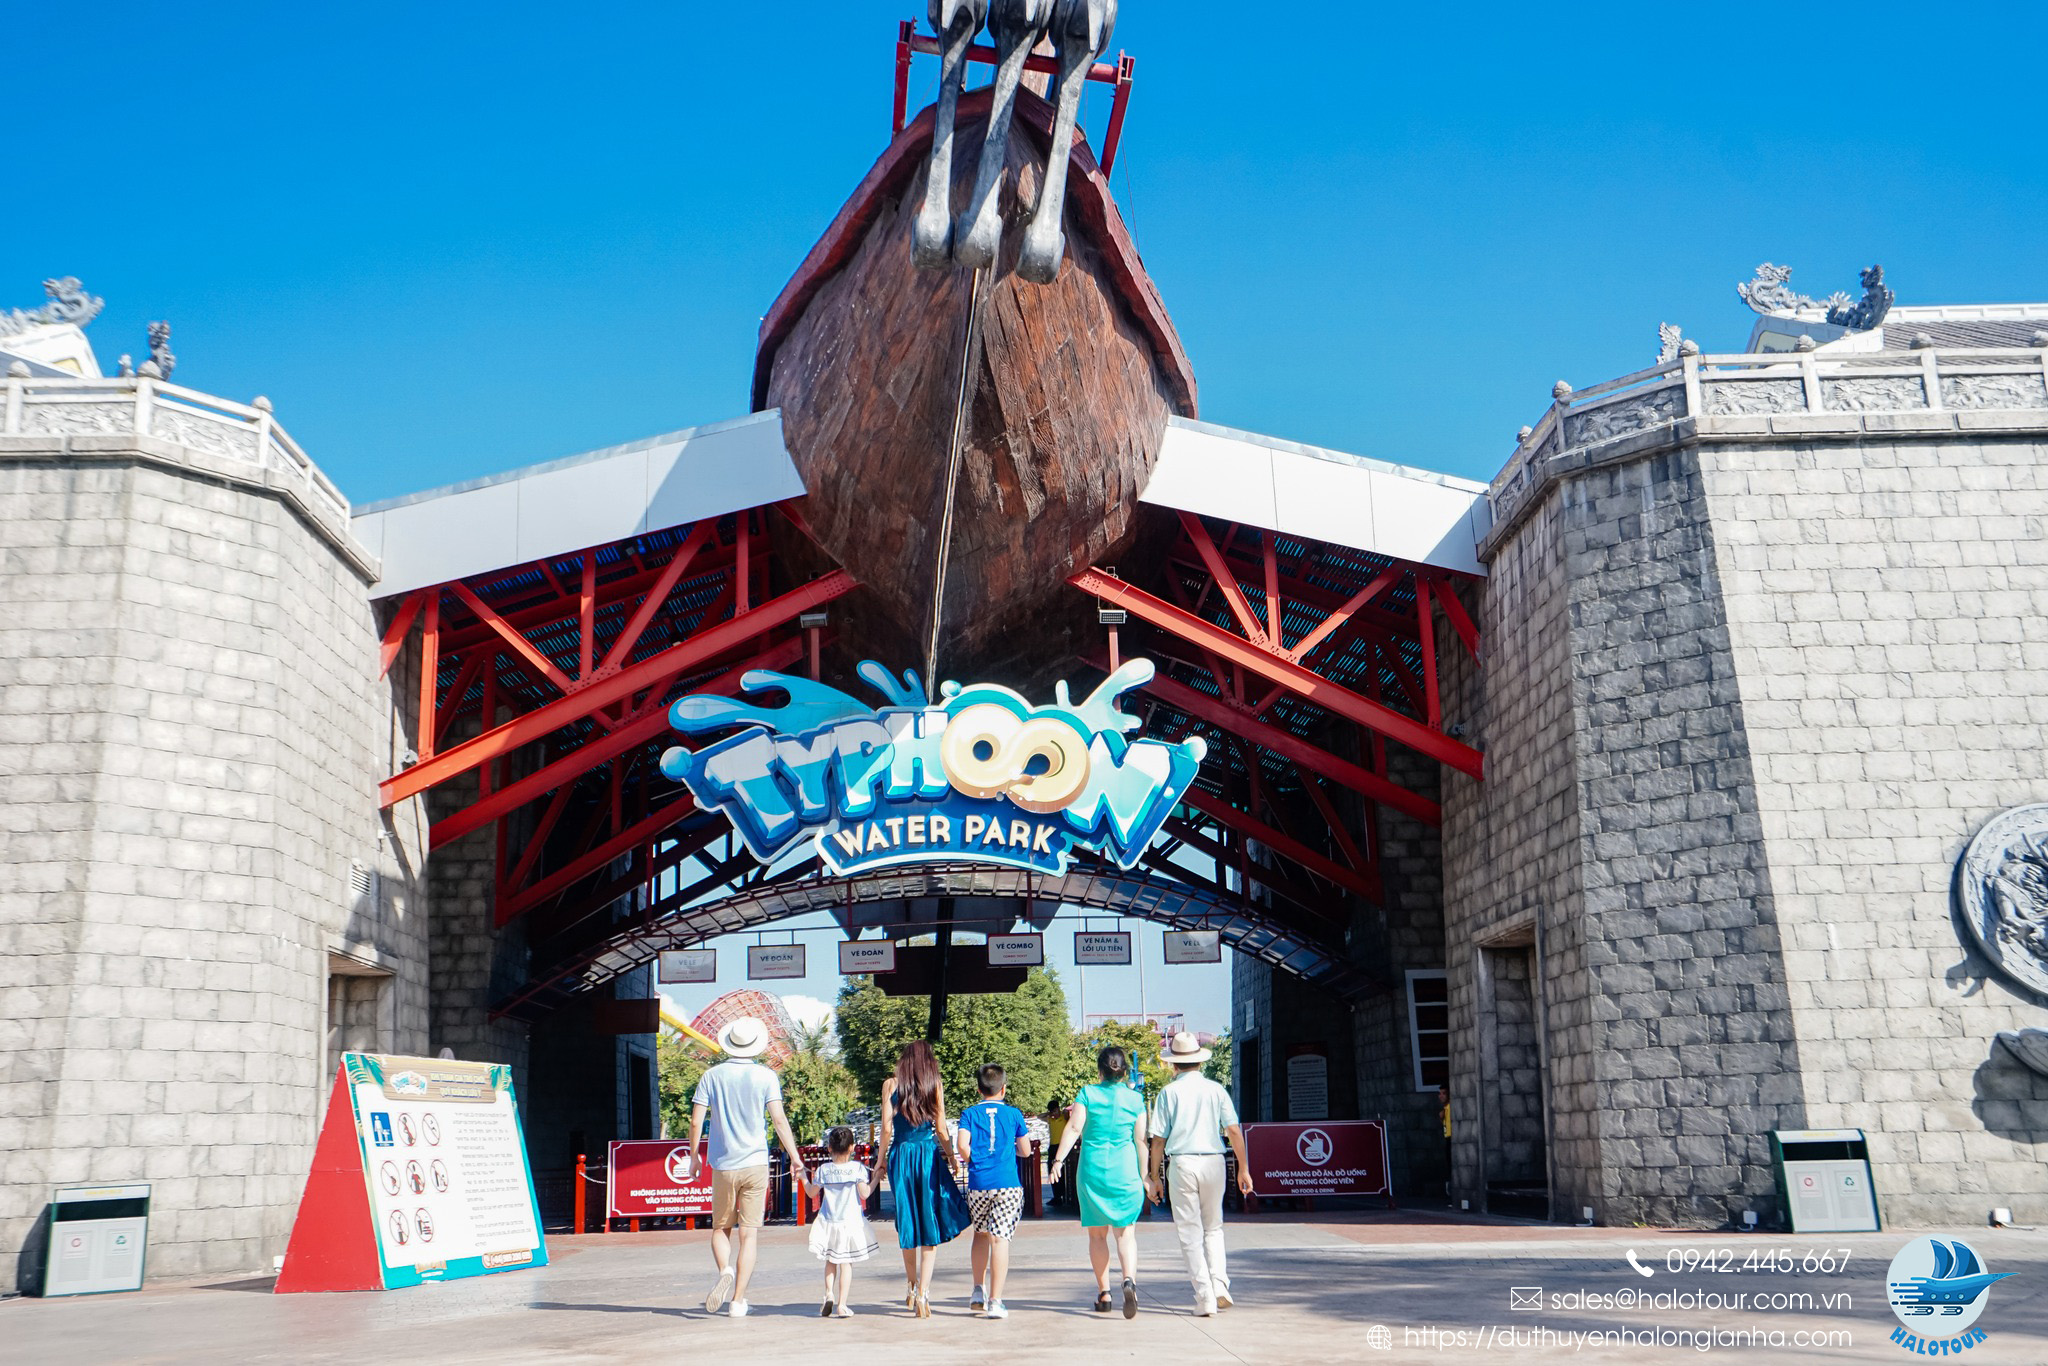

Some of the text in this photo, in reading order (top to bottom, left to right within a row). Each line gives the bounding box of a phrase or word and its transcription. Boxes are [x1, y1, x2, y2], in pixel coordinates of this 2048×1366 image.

[700, 700, 1178, 847] TYPHOON
[833, 815, 1059, 859] WATER PARK
[1006, 942, 1034, 950] COMBO
[861, 947, 884, 957] ĐOÀN
[1264, 1170, 1289, 1178] KHÔNG
[1311, 1168, 1323, 1177] ĐỒ
[1335, 1168, 1346, 1176] ĐỒ
[1346, 1168, 1367, 1176] UỐNG
[1280, 1177, 1294, 1186] VÀO
[1318, 1177, 1338, 1185] CÔNG
[1338, 1176, 1355, 1185] VIÊN
[630, 1189, 656, 1197] KHÔNG
[678, 1186, 689, 1195] ĐỒ
[645, 1196, 660, 1205] VÀO
[661, 1196, 684, 1204] TRONG
[685, 1195, 705, 1203] CÔNG
